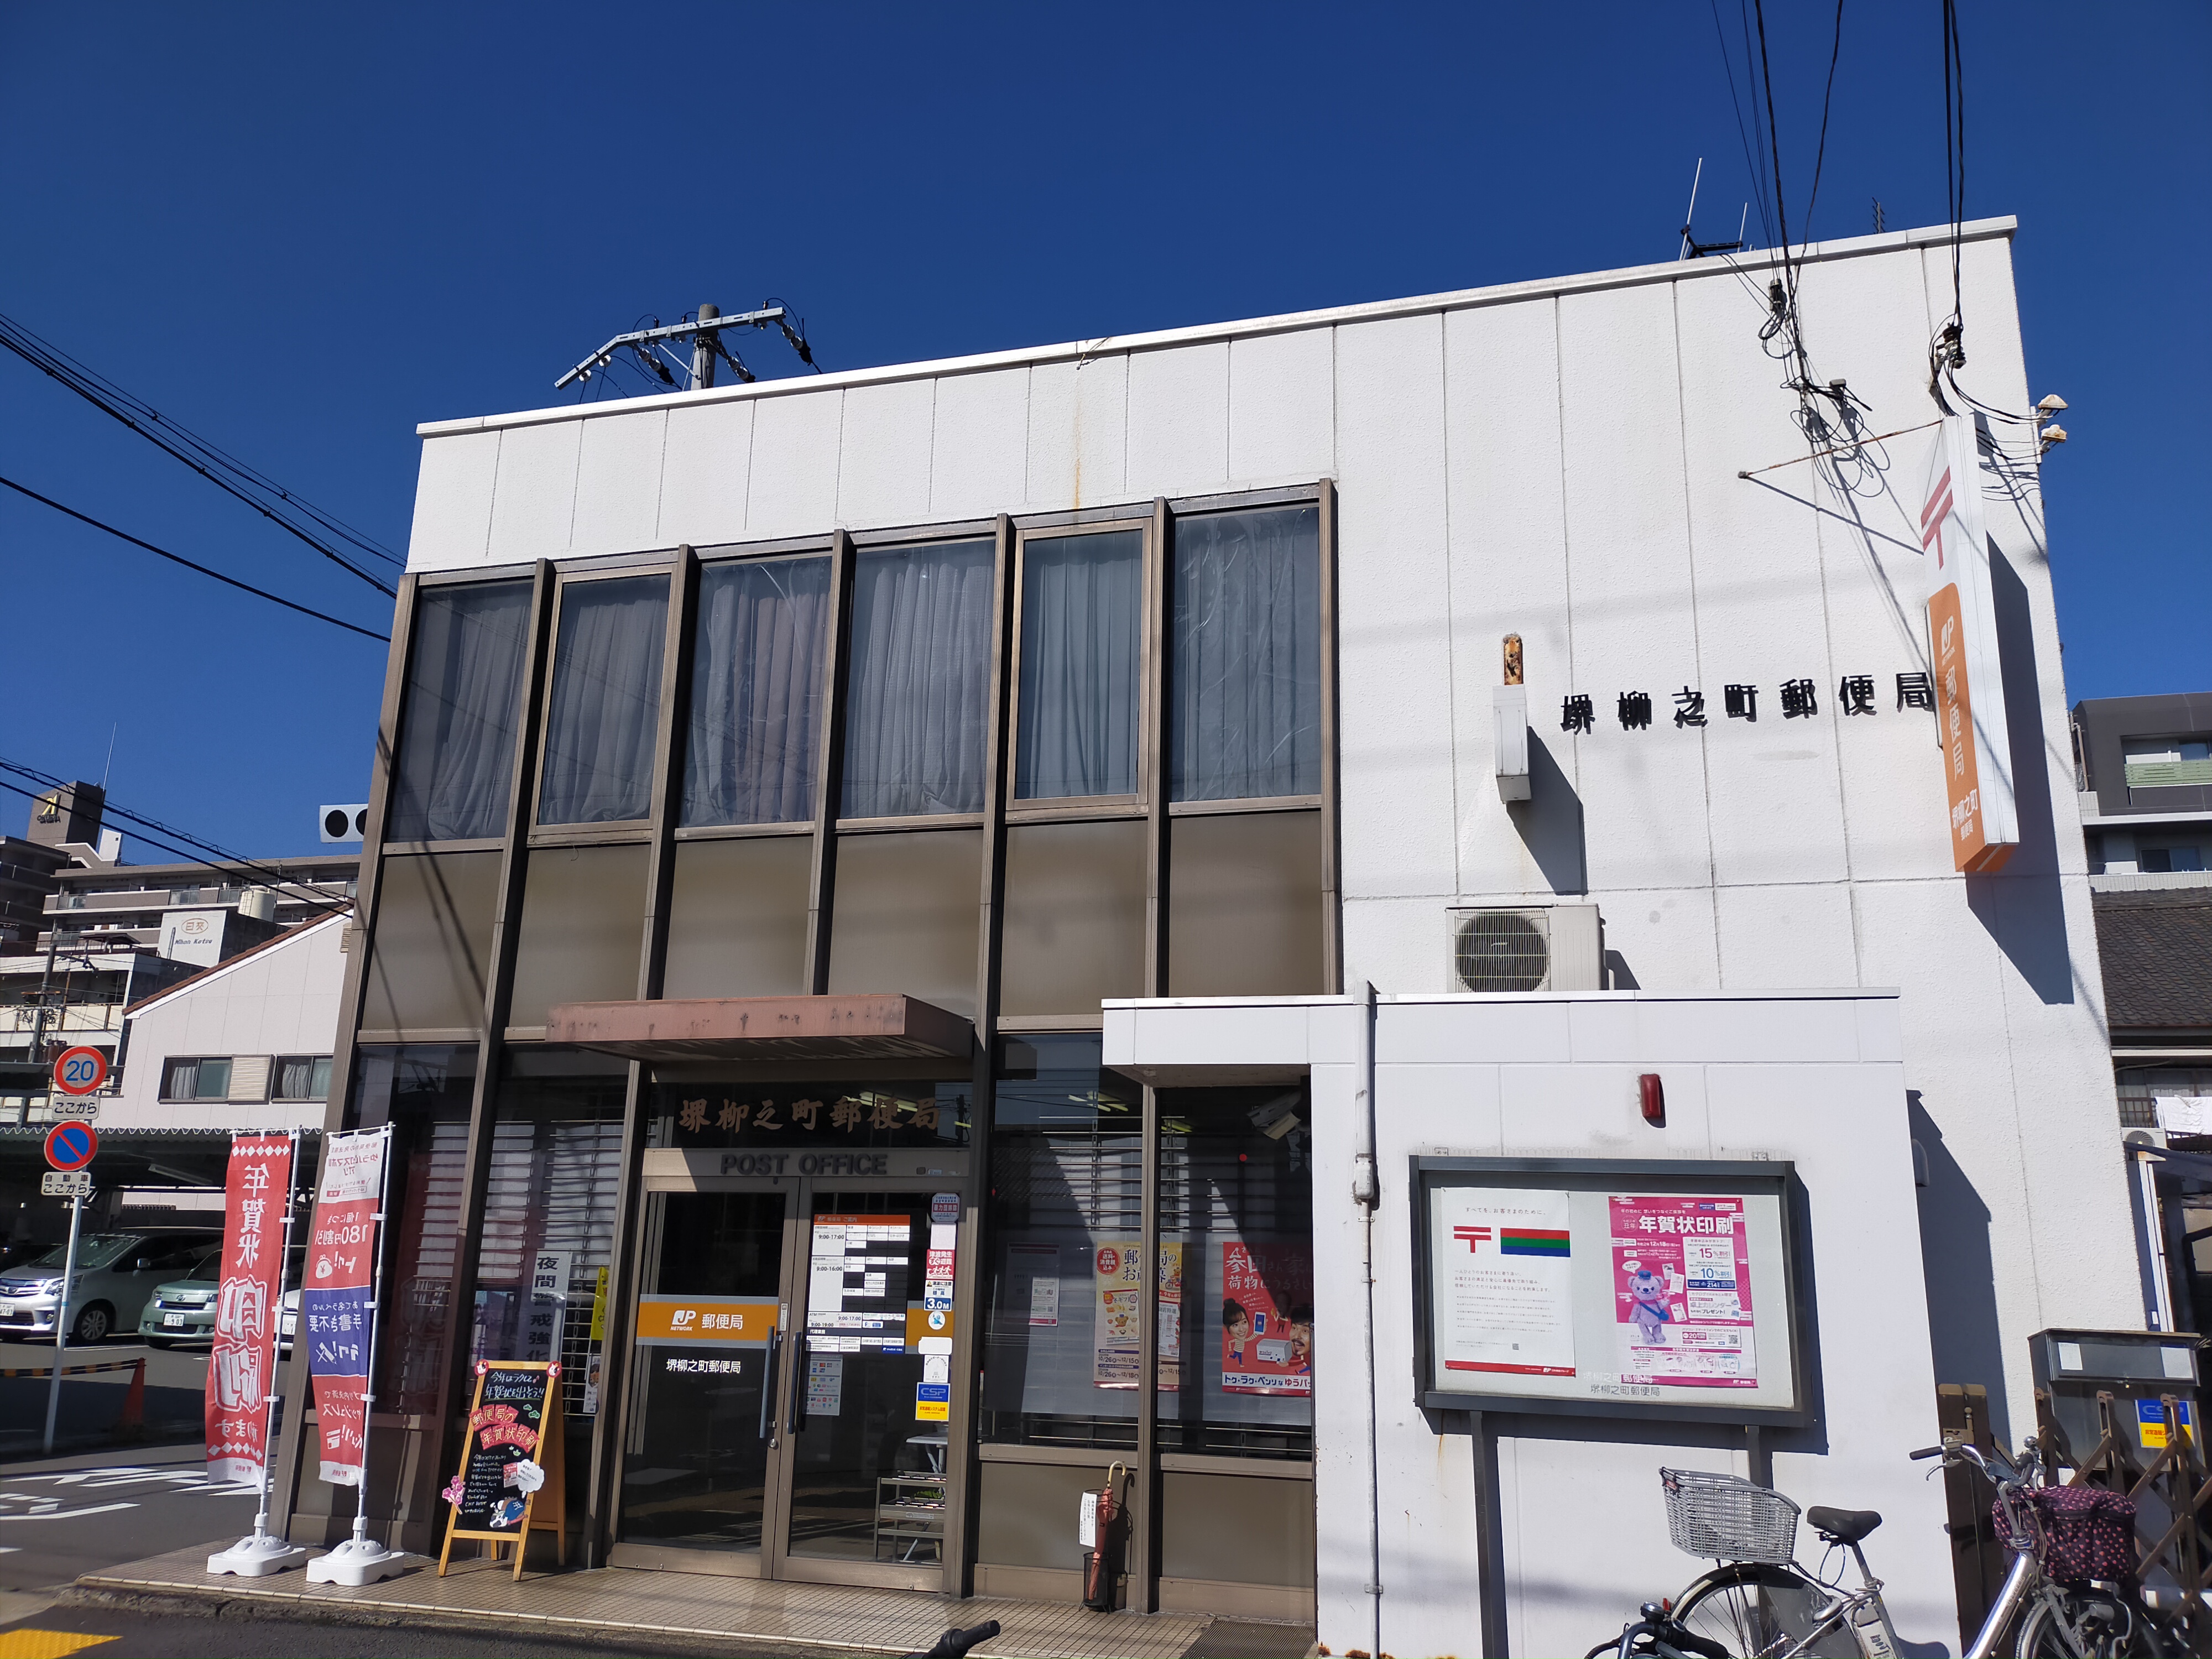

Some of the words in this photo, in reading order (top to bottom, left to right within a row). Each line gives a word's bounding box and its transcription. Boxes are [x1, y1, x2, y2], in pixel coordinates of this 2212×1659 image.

[1561, 672, 1931, 726] 堺柳之町郵便局
[1945, 665, 1964, 781] 郵便局
[65, 1060, 95, 1081] 20
[54, 1102, 97, 1114] ここから
[678, 1093, 940, 1134] 堺柳之町郵便局
[720, 1153, 788, 1176] POST
[798, 1152, 888, 1175] OFFICE
[45, 1174, 88, 1182] 自動車
[43, 1183, 87, 1194] ここから
[1465, 1207, 1548, 1215] すべてを、お客さまのために。
[1639, 1215, 1734, 1234] 年賀状印刷
[526, 1256, 560, 1361] 夜間警戒強化
[927, 1298, 949, 1310] 3.0M
[701, 1313, 743, 1329] 郵便局
[666, 1358, 741, 1374] 堺柳之町郵便局
[921, 1387, 946, 1396] CSP
[472, 1408, 514, 1427] 郵便局の
[482, 1426, 538, 1451] 年賀状印刷
